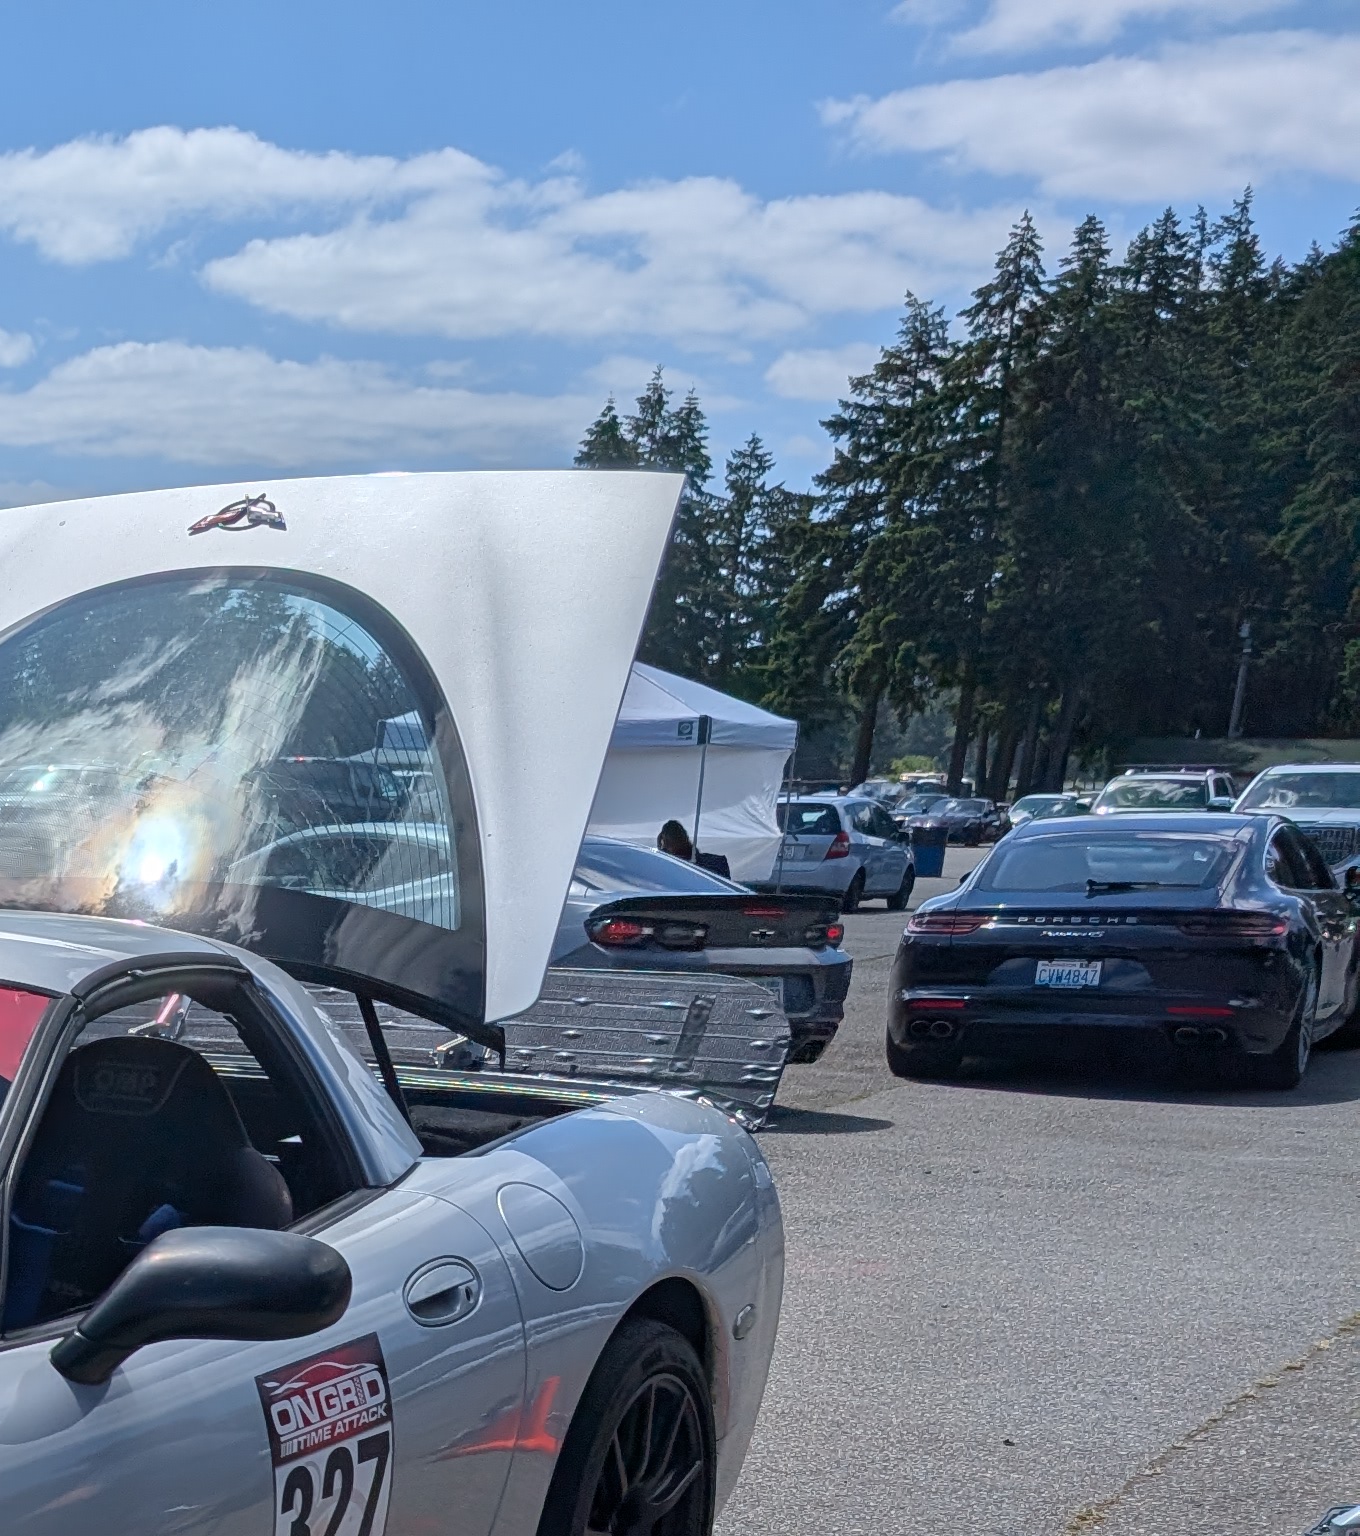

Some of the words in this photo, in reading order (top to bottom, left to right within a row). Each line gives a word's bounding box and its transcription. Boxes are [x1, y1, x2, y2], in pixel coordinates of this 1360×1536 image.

[1017, 916, 1138, 924] PORSCHE
[1038, 968, 1098, 985] CVW4847
[296, 1425, 332, 1450] TIME
[334, 1403, 387, 1436] ATTACK
